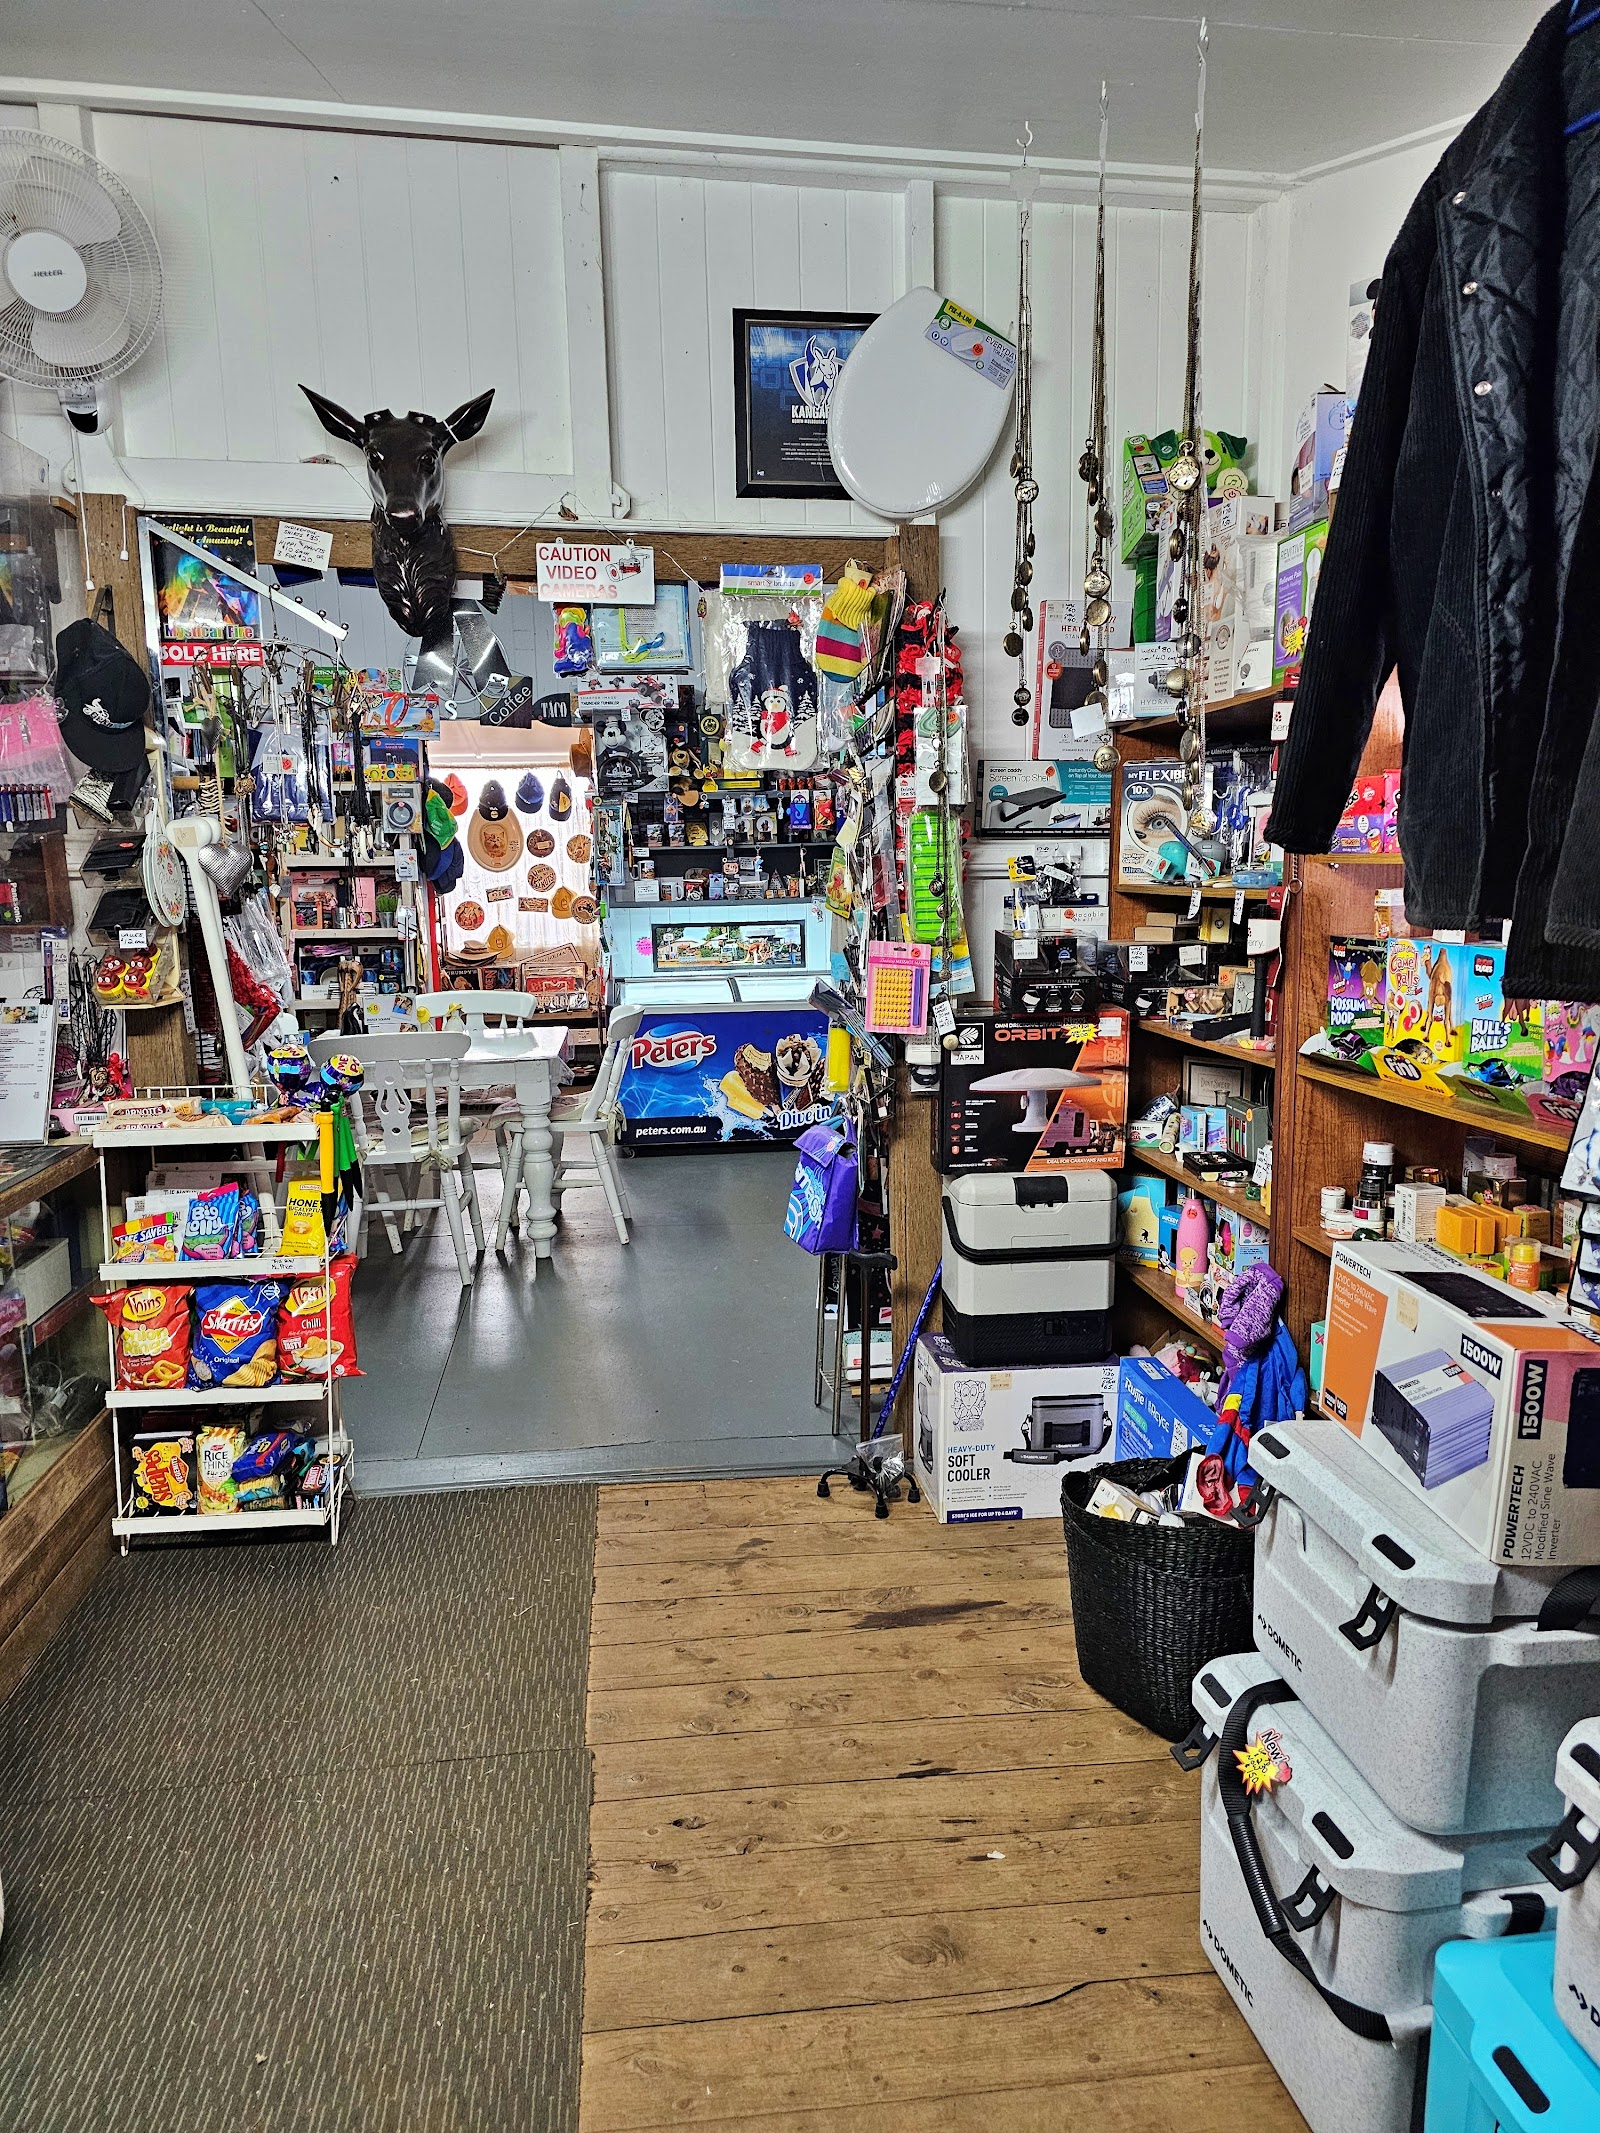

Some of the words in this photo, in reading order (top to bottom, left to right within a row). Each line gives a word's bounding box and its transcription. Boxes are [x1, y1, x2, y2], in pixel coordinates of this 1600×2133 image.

[206, 523, 250, 534] Beautiful
[538, 545, 612, 563] CAUTION
[545, 565, 598, 581] VIDEO
[539, 582, 618, 599] CAMERAS
[225, 624, 255, 640] Fire
[160, 645, 208, 662] SOLD
[212, 645, 262, 662] HERE
[487, 686, 534, 725] Coffee
[540, 701, 569, 719] TACO
[1210, 748, 1237, 757] Ultimate
[988, 773, 1017, 783] Screen
[1018, 774, 1031, 784] Top
[1131, 785, 1149, 795] 10x
[9, 879, 22, 923] Panasonic
[1331, 995, 1366, 1012] POSSUM
[1330, 1011, 1355, 1026] POOP
[1471, 1017, 1512, 1036] BULL'S
[630, 1034, 717, 1070] Peters
[1469, 1034, 1509, 1054] BALLS
[955, 1054, 981, 1062] JAPAN
[1384, 1056, 1421, 1080] Fini
[778, 1107, 815, 1131] Dive
[815, 1103, 833, 1122] in
[635, 1125, 707, 1138] peters.com.au
[191, 1204, 220, 1222] Big
[292, 1210, 314, 1218] DROPS
[139, 1224, 174, 1242] SAVERS
[185, 1216, 225, 1238] Lolly
[1335, 1250, 1372, 1280] POWERTECH
[1336, 1271, 1351, 1289] 12VDC
[1356, 1284, 1376, 1304] 240VAC
[126, 1290, 162, 1315] Thins
[1334, 1281, 1354, 1301] Modified
[1363, 1301, 1378, 1317] Wave
[203, 1313, 259, 1332] SMITH'S
[301, 1317, 322, 1330] Chilli
[122, 1325, 170, 1342] Onion
[122, 1339, 173, 1357] Rings
[1461, 1337, 1502, 1376] 1500W
[213, 1355, 241, 1365] Original
[1521, 1363, 1545, 1437] 1500W
[203, 1450, 229, 1462] RICE
[947, 1443, 996, 1454] HEAVY-DUTY
[202, 1459, 231, 1470] THINS
[947, 1454, 976, 1468] SOFT
[1544, 1453, 1556, 1485] Wave
[947, 1467, 991, 1482] COOLER
[1529, 1460, 1543, 1505] 240VAC
[1541, 1487, 1552, 1512] Sine
[1503, 1464, 1525, 1559] POWERTECH
[1527, 1507, 1537, 1519] to
[1520, 1524, 1535, 1560] 12VDC
[1534, 1512, 1550, 1560] Modified
[1549, 1518, 1562, 1560] Inverter
[1267, 1624, 1304, 1673] DOMETIC
[1260, 1729, 1291, 1765] New!
[1213, 1936, 1255, 2008] DOMETIC
